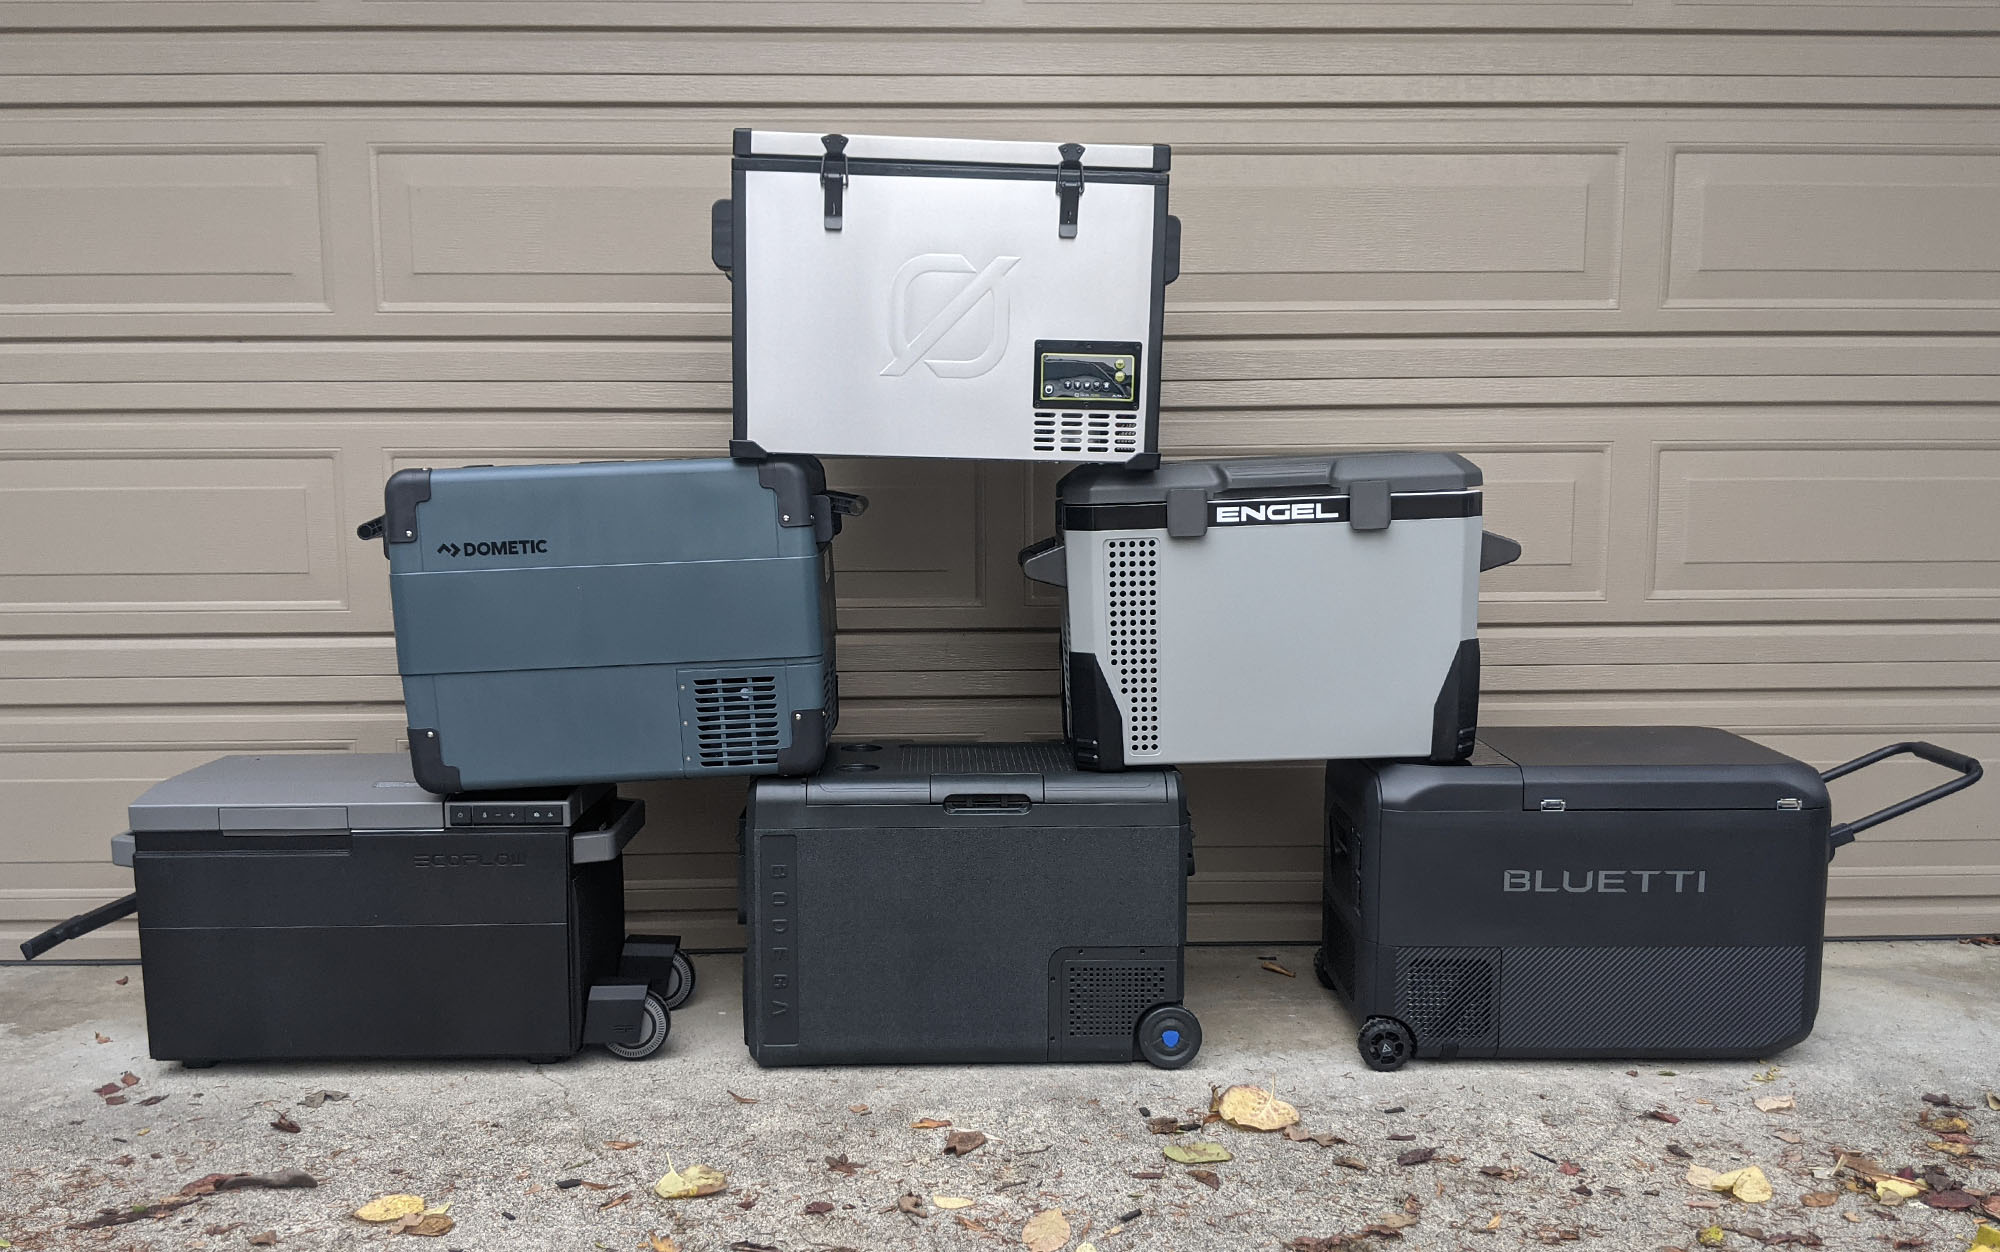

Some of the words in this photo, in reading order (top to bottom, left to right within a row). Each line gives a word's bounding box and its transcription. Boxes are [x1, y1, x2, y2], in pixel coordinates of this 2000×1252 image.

[1216, 503, 1339, 522] ENGEL
[463, 540, 547, 556] DOMETIC
[413, 853, 527, 868] ECOFLOW
[1503, 869, 1706, 893] BLUETTI
[771, 864, 788, 1015] BODEGA
